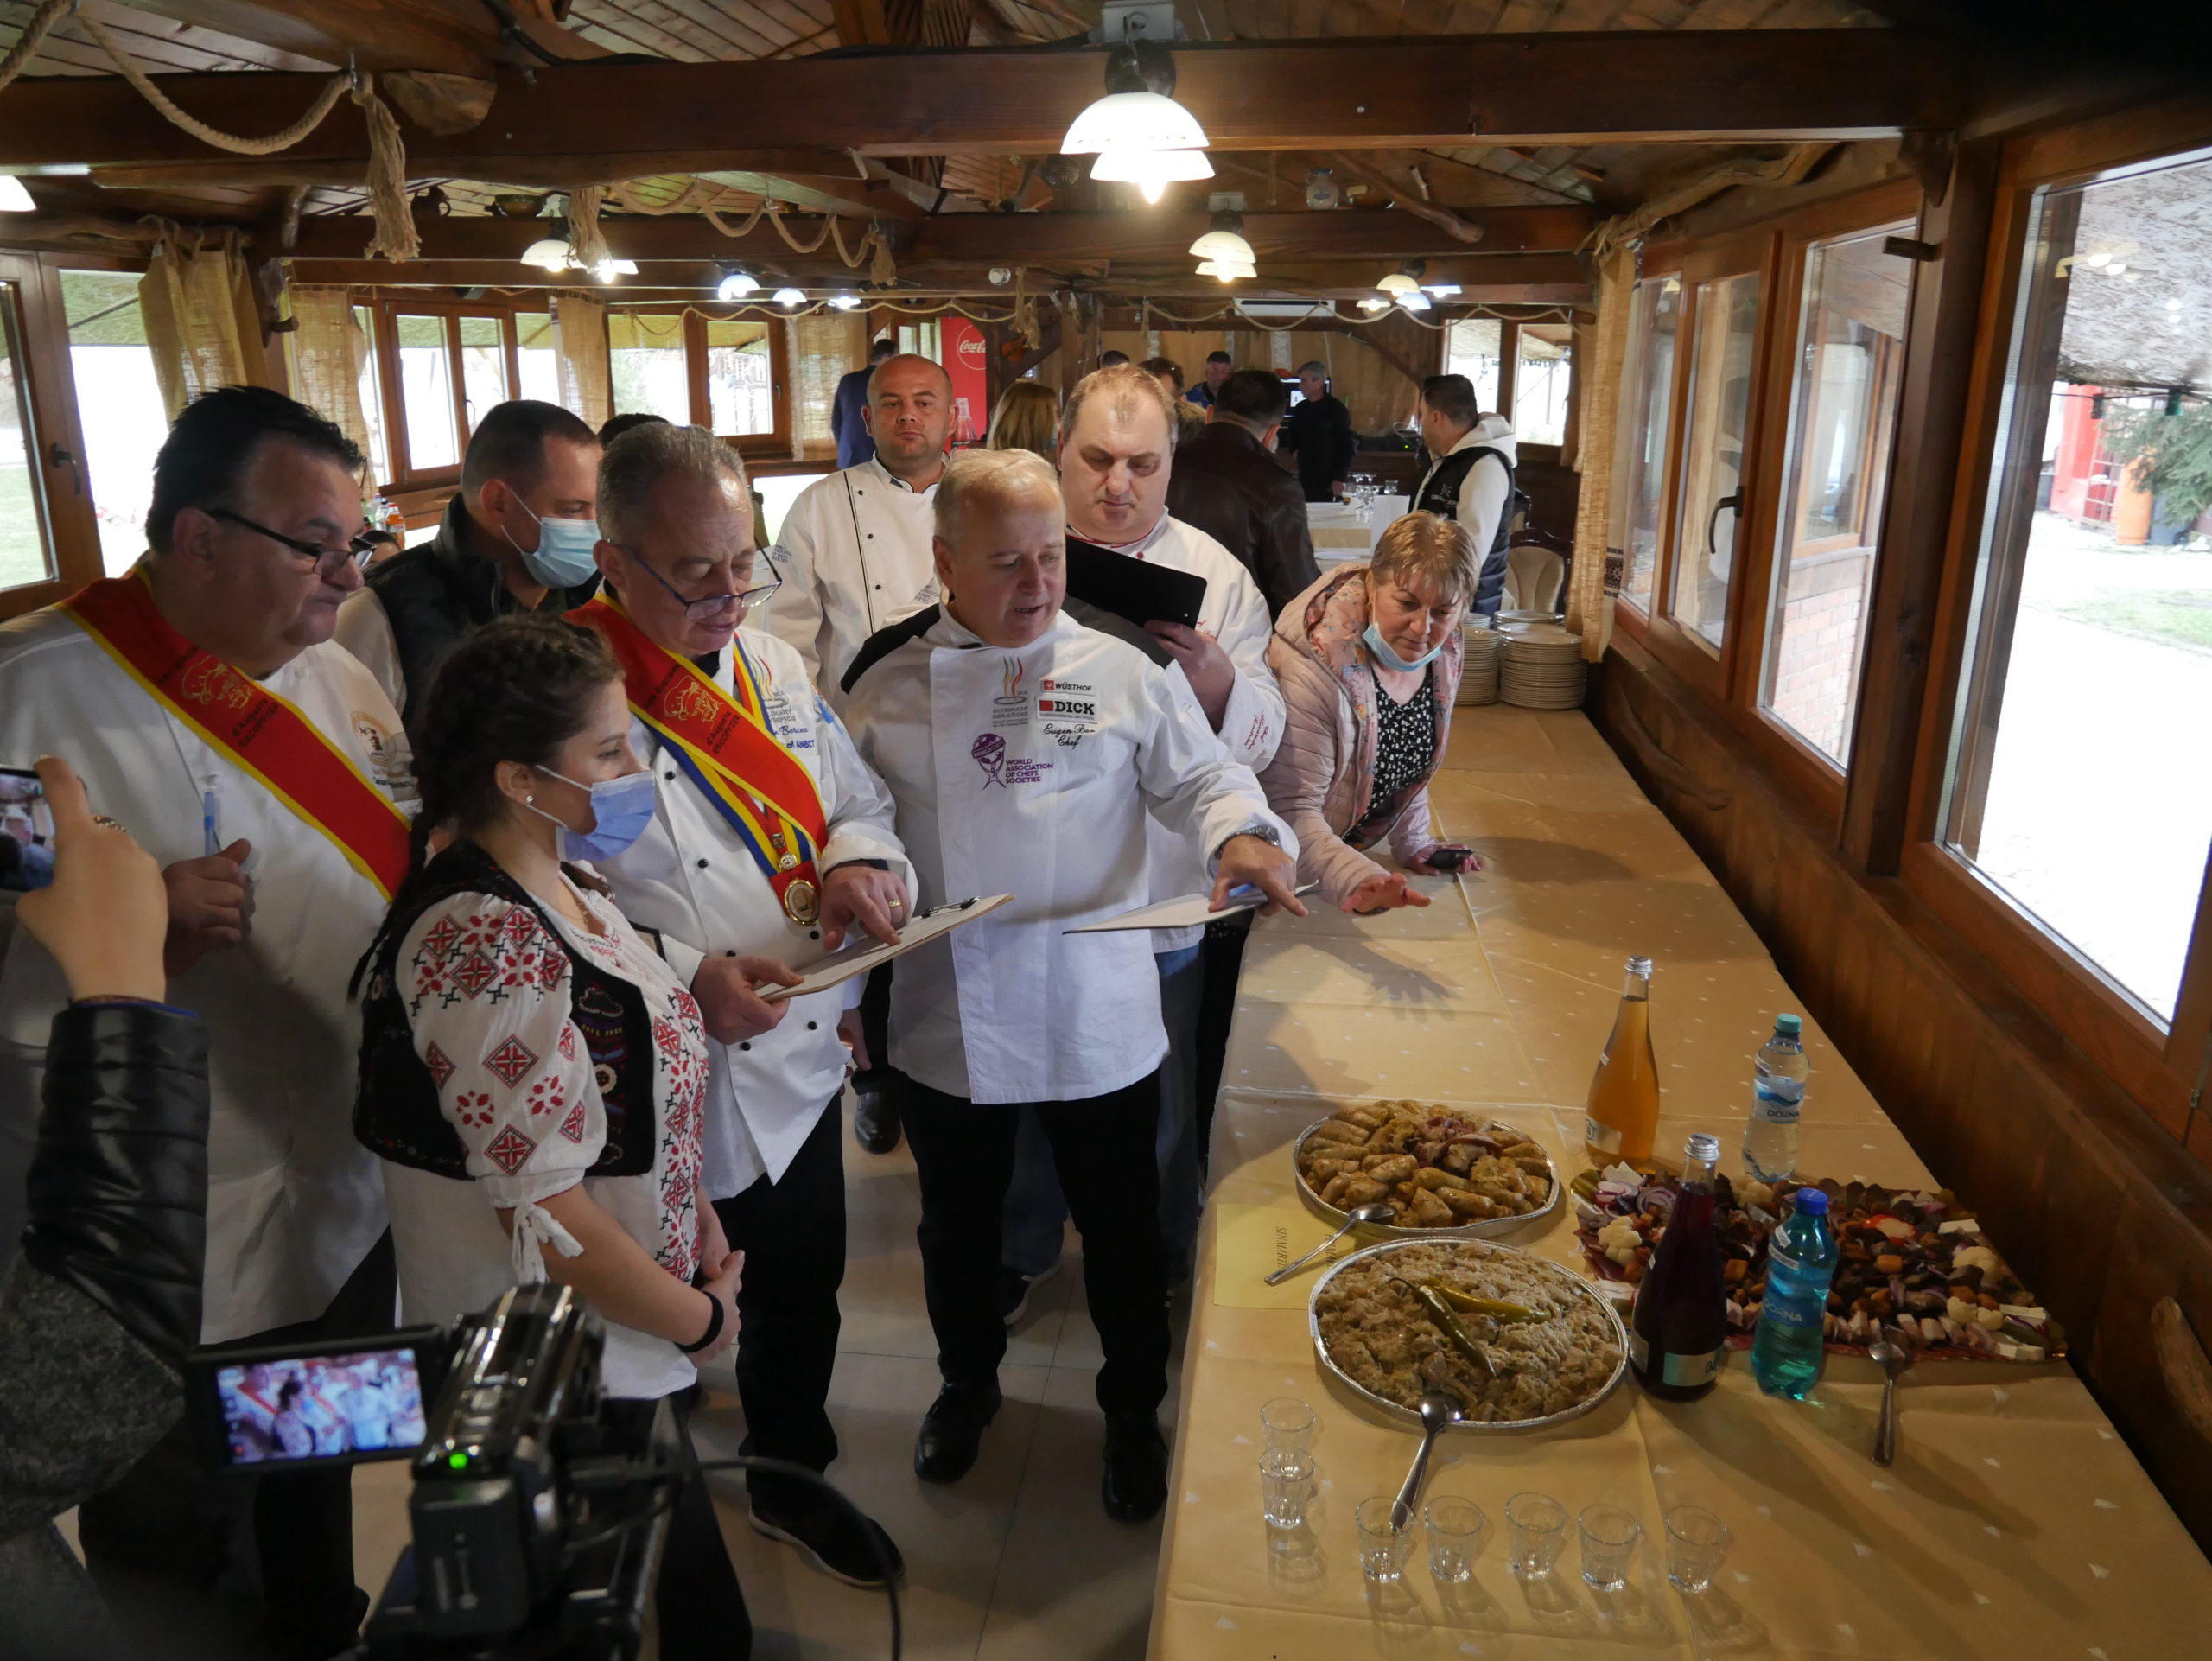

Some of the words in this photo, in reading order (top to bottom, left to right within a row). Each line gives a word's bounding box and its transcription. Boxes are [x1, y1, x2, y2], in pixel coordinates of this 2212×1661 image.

[1055, 681, 1092, 691] WÜSTHOF
[1054, 700, 1095, 716] DICK
[1044, 723, 1072, 738] Eugen
[1055, 735, 1082, 750] Chef
[1006, 763, 1053, 772] ASSOCIATION
[1767, 1109, 1800, 1118] DORNA
[1764, 1297, 1802, 1321] DORNA
